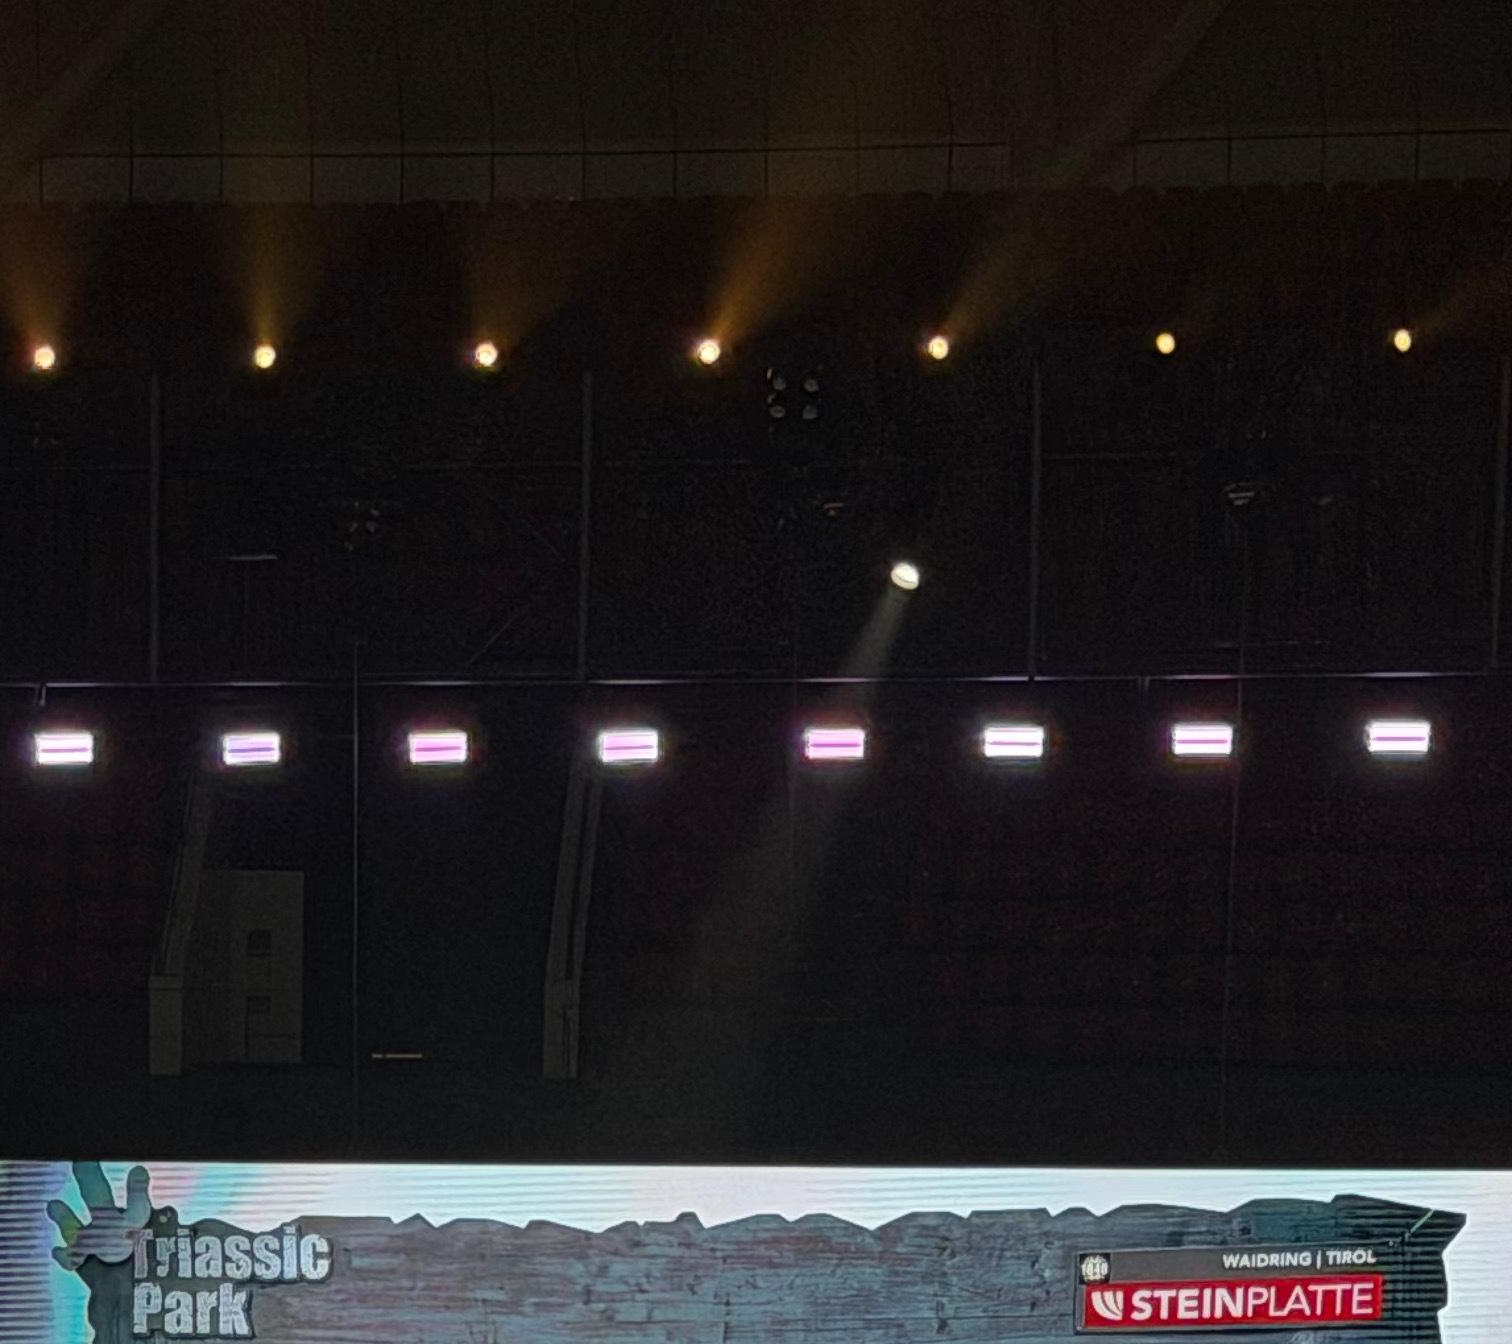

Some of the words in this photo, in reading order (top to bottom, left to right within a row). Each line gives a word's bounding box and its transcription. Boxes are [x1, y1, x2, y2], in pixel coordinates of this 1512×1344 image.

[1222, 1252, 1311, 1269] WAIDRING
[1326, 1249, 1376, 1265] TIROL
[133, 1282, 250, 1335] Park
[1131, 1282, 1375, 1321] STEINPLATTE
